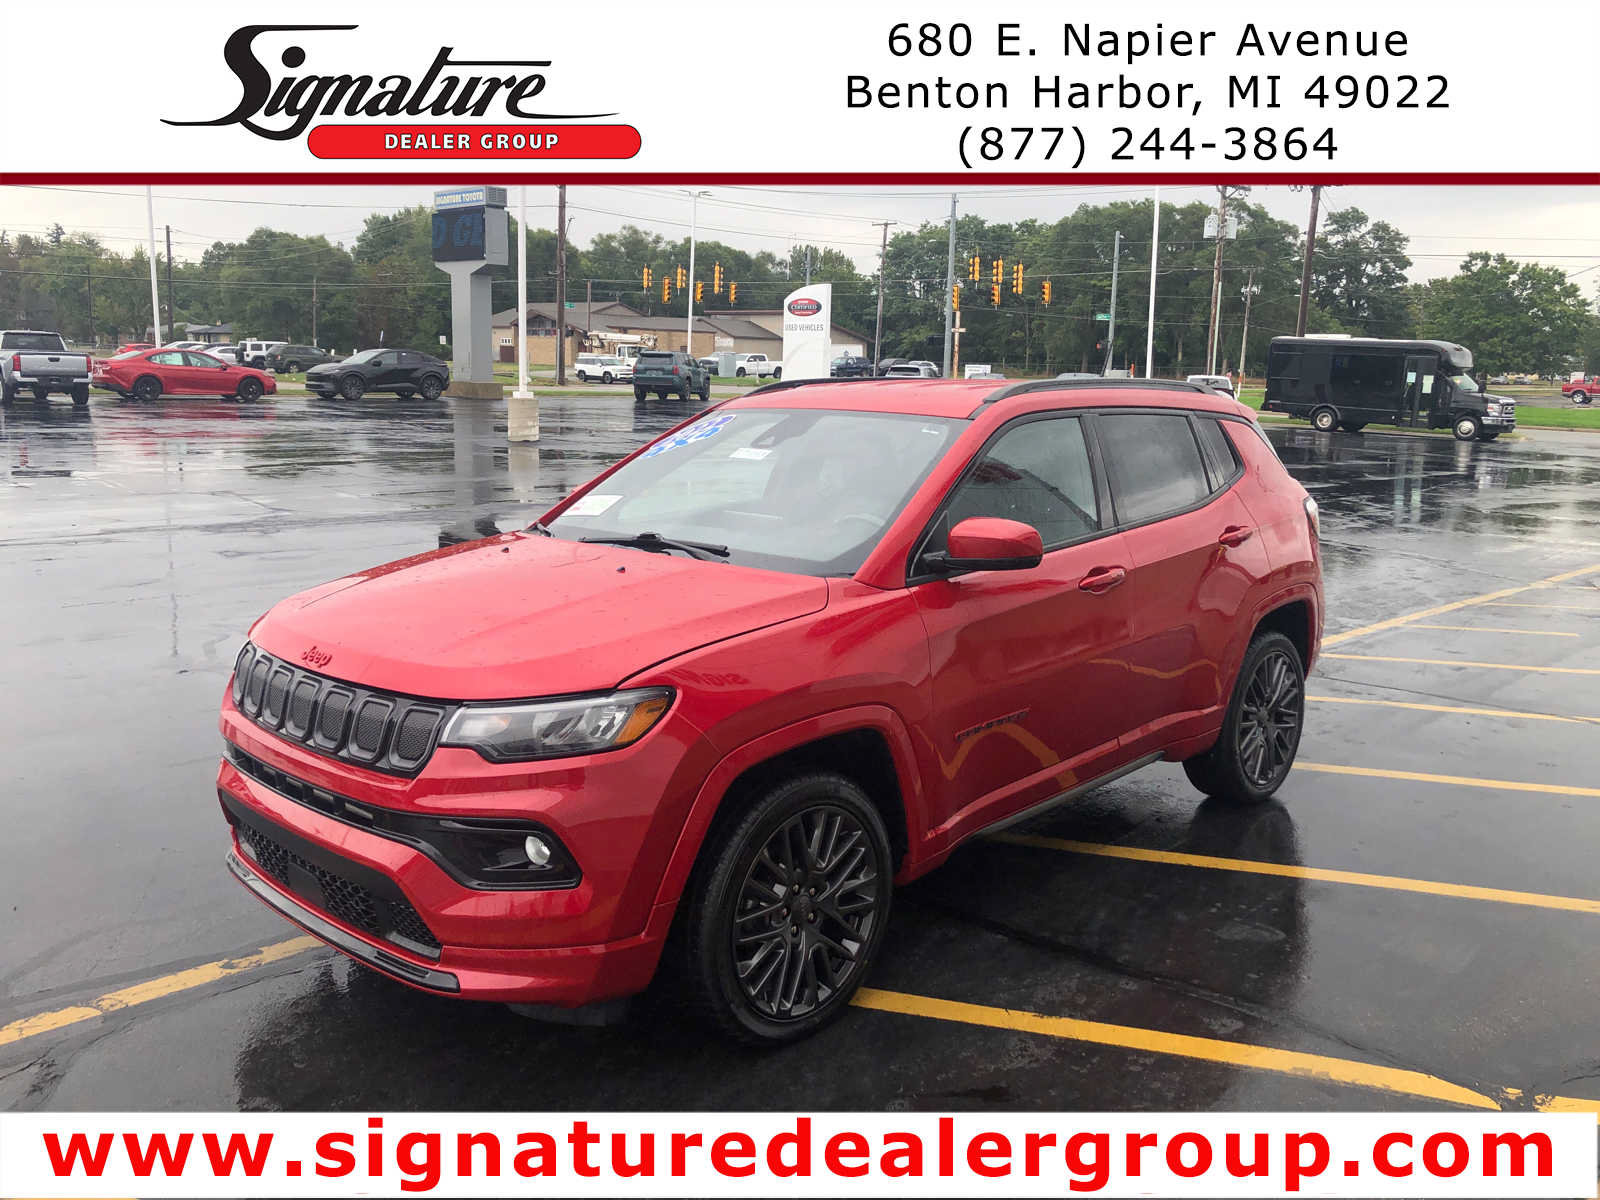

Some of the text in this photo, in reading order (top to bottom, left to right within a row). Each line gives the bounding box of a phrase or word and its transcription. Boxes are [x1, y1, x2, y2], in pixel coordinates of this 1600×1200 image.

[784, 323, 824, 332] USED VEHICLES
[301, 645, 333, 669] Jeep
